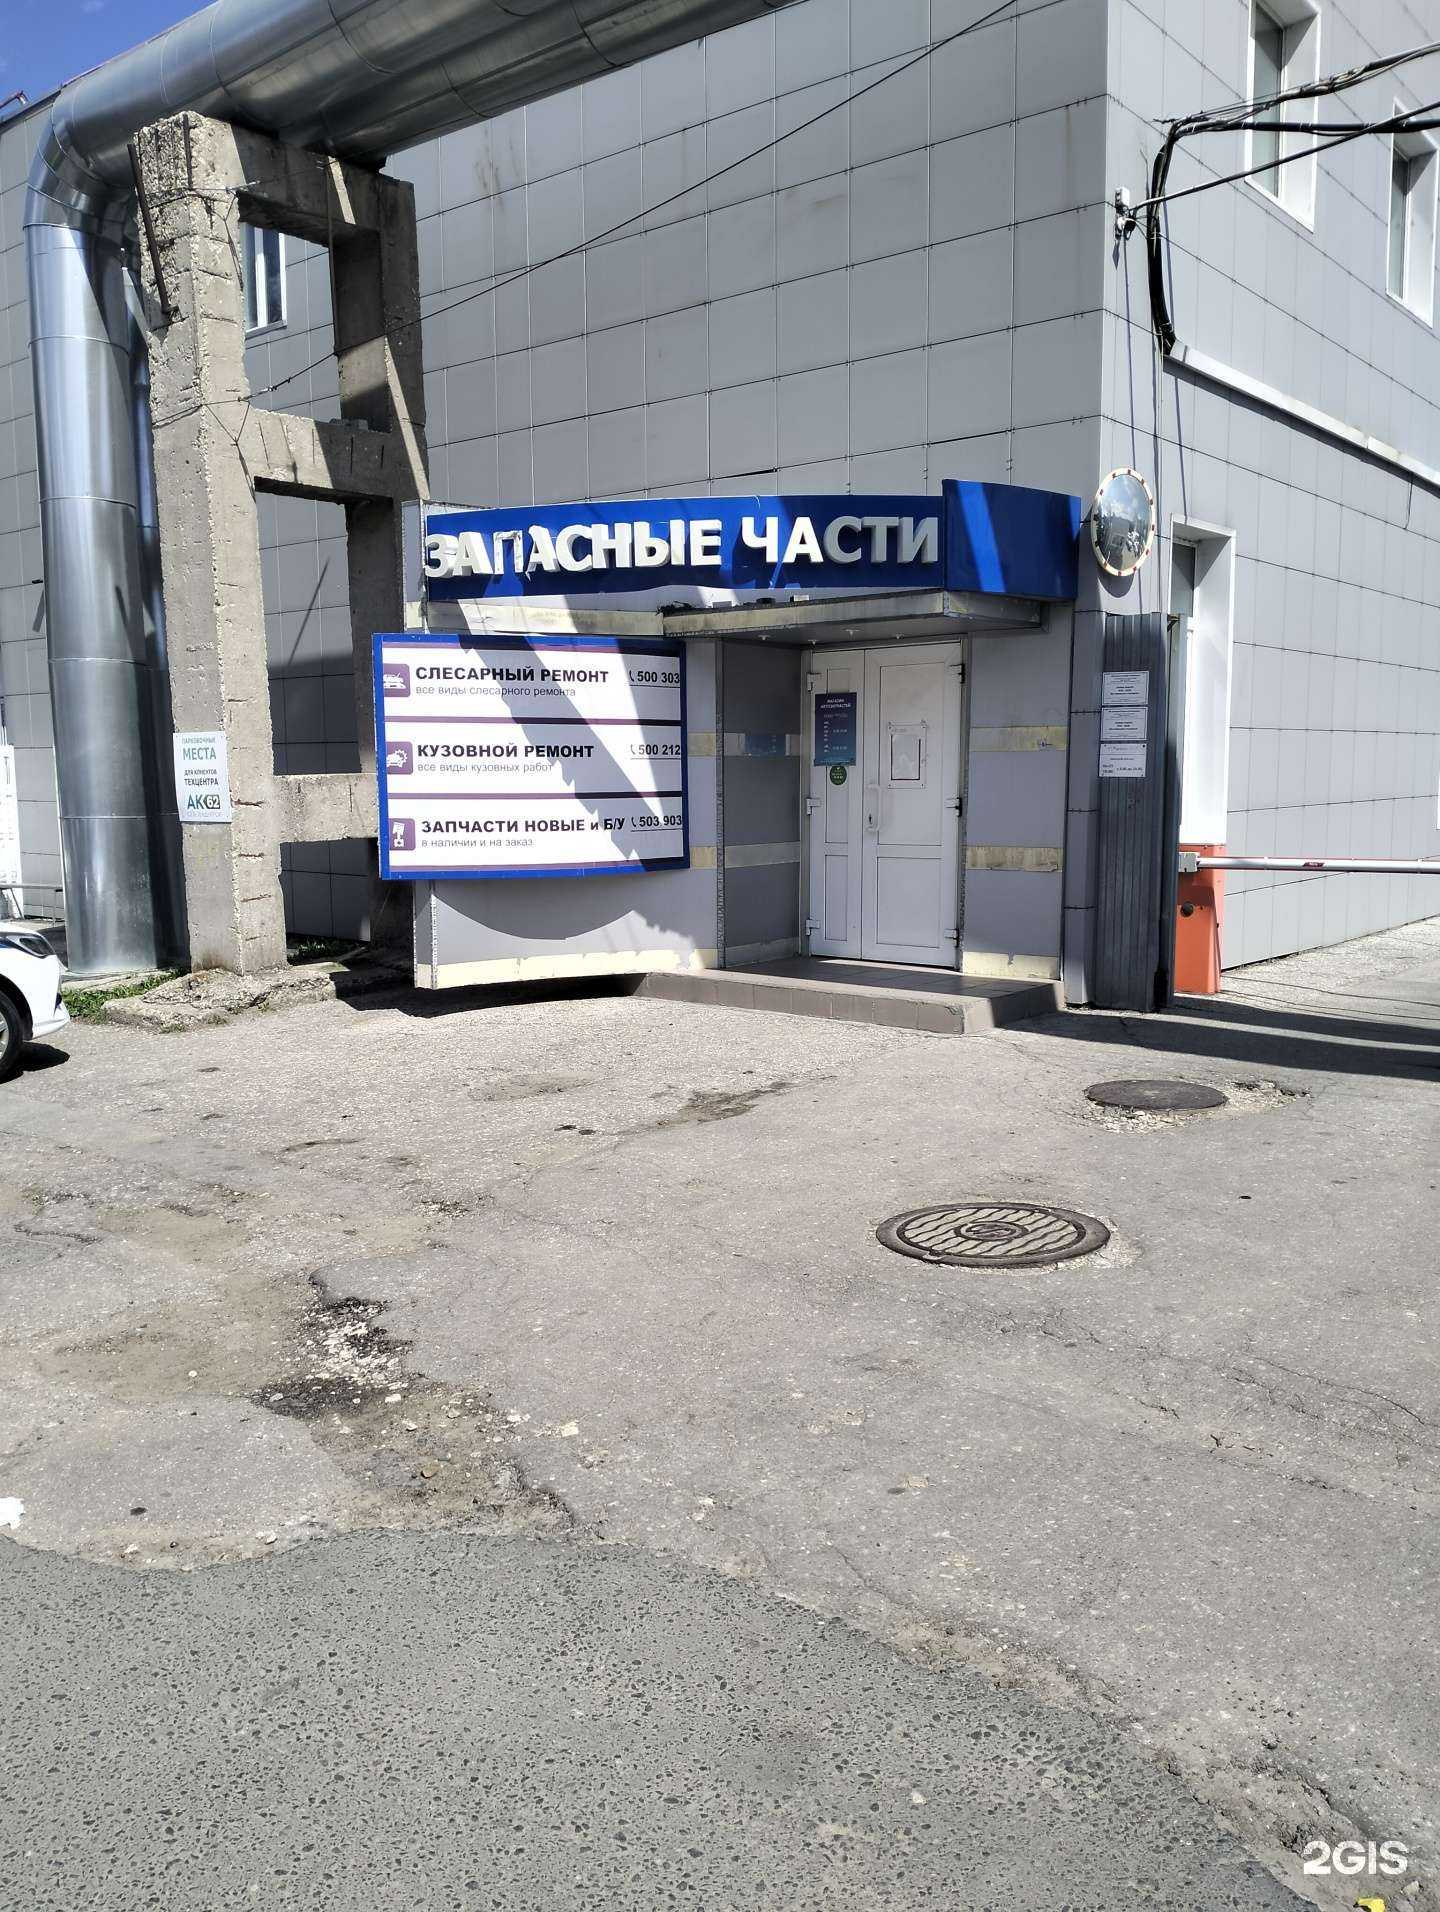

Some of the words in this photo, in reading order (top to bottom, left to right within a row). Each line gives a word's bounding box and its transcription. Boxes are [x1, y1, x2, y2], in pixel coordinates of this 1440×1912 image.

[423, 519, 722, 579] ЗАПАСНЫЕ
[741, 516, 940, 565] ЧАСТИ
[415, 665, 535, 682] СЛЕСАРНЫЙ
[540, 668, 609, 683] РЕМОНТ
[637, 670, 658, 683] 500
[661, 671, 681, 684] 303
[415, 686, 435, 695] все
[438, 686, 467, 696] виды
[470, 686, 531, 697] слесарного
[533, 687, 576, 698] ремонта
[182, 747, 217, 761] МЕСТА
[417, 742, 518, 758] КУЗОВНОЙ
[524, 745, 594, 758] РЕМОНТ
[638, 745, 659, 756] 500
[661, 744, 681, 756] 212
[417, 763, 437, 772] все
[439, 763, 468, 773] виды
[471, 763, 520, 774] кузовных
[523, 762, 553, 774] работ
[184, 777, 219, 786] ТЕХЦЕНТРА
[421, 819, 518, 833] ЗАПЧАСТИ
[524, 819, 585, 832] НОВЫЕ
[590, 822, 599, 831] и
[603, 817, 625, 830] Б/У
[638, 816, 660, 828] 503
[663, 815, 682, 827] 903
[431, 838, 477, 847] наличии
[479, 838, 487, 847] и
[489, 838, 502, 847] на
[505, 838, 534, 847] заказ
